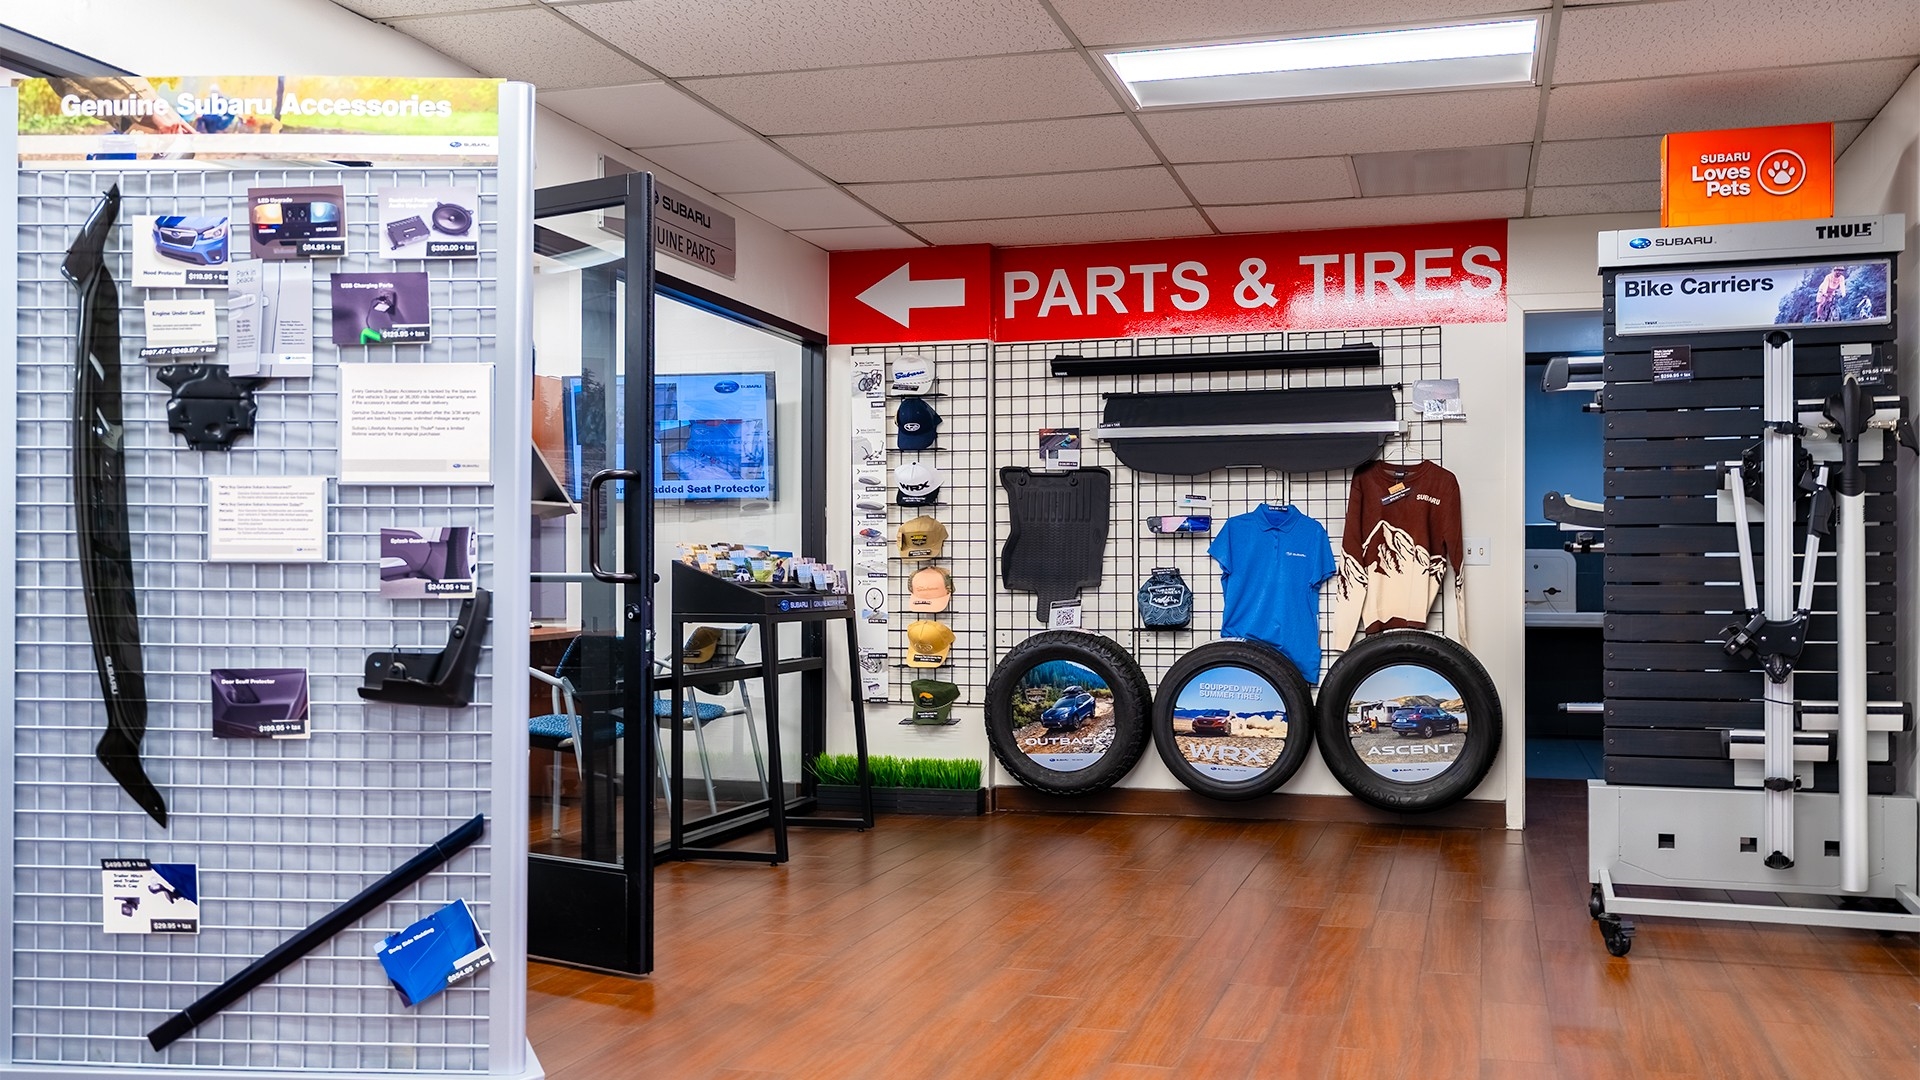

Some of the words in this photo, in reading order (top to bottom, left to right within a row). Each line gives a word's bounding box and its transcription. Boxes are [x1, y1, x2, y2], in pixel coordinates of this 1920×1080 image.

[60, 93, 170, 117] Genuine
[176, 92, 273, 116] Subaru
[281, 92, 452, 118] Accessories
[1701, 152, 1750, 164] SUBARU
[1692, 165, 1750, 182] Loves
[1706, 181, 1750, 197] Pets
[662, 195, 711, 229] SUBARU
[1655, 236, 1713, 246] SUBARU
[1816, 222, 1872, 240] THULE
[656, 226, 684, 253] UINE
[686, 238, 716, 266] PARTS
[1004, 260, 1210, 319] PARTS
[1233, 258, 1279, 309] &
[1299, 246, 1502, 312] TIRES
[1624, 280, 1674, 298] Bike
[1680, 276, 1774, 295] Carriers
[895, 370, 925, 379] Subaru
[654, 485, 684, 493] added
[687, 485, 712, 493] Seat
[714, 484, 765, 493] Protector
[899, 480, 930, 491] WRX
[1416, 494, 1441, 505] SUBARU
[104, 656, 118, 694] SUBARU
[1200, 683, 1240, 692] EQUIPPED
[1200, 691, 1234, 700] SUMMER
[1025, 737, 1102, 746] OUTBACK
[1189, 743, 1264, 763] WRX
[1367, 744, 1454, 756] ASCENT
[388, 945, 402, 954] Body
[480, 958, 490, 966] tax
